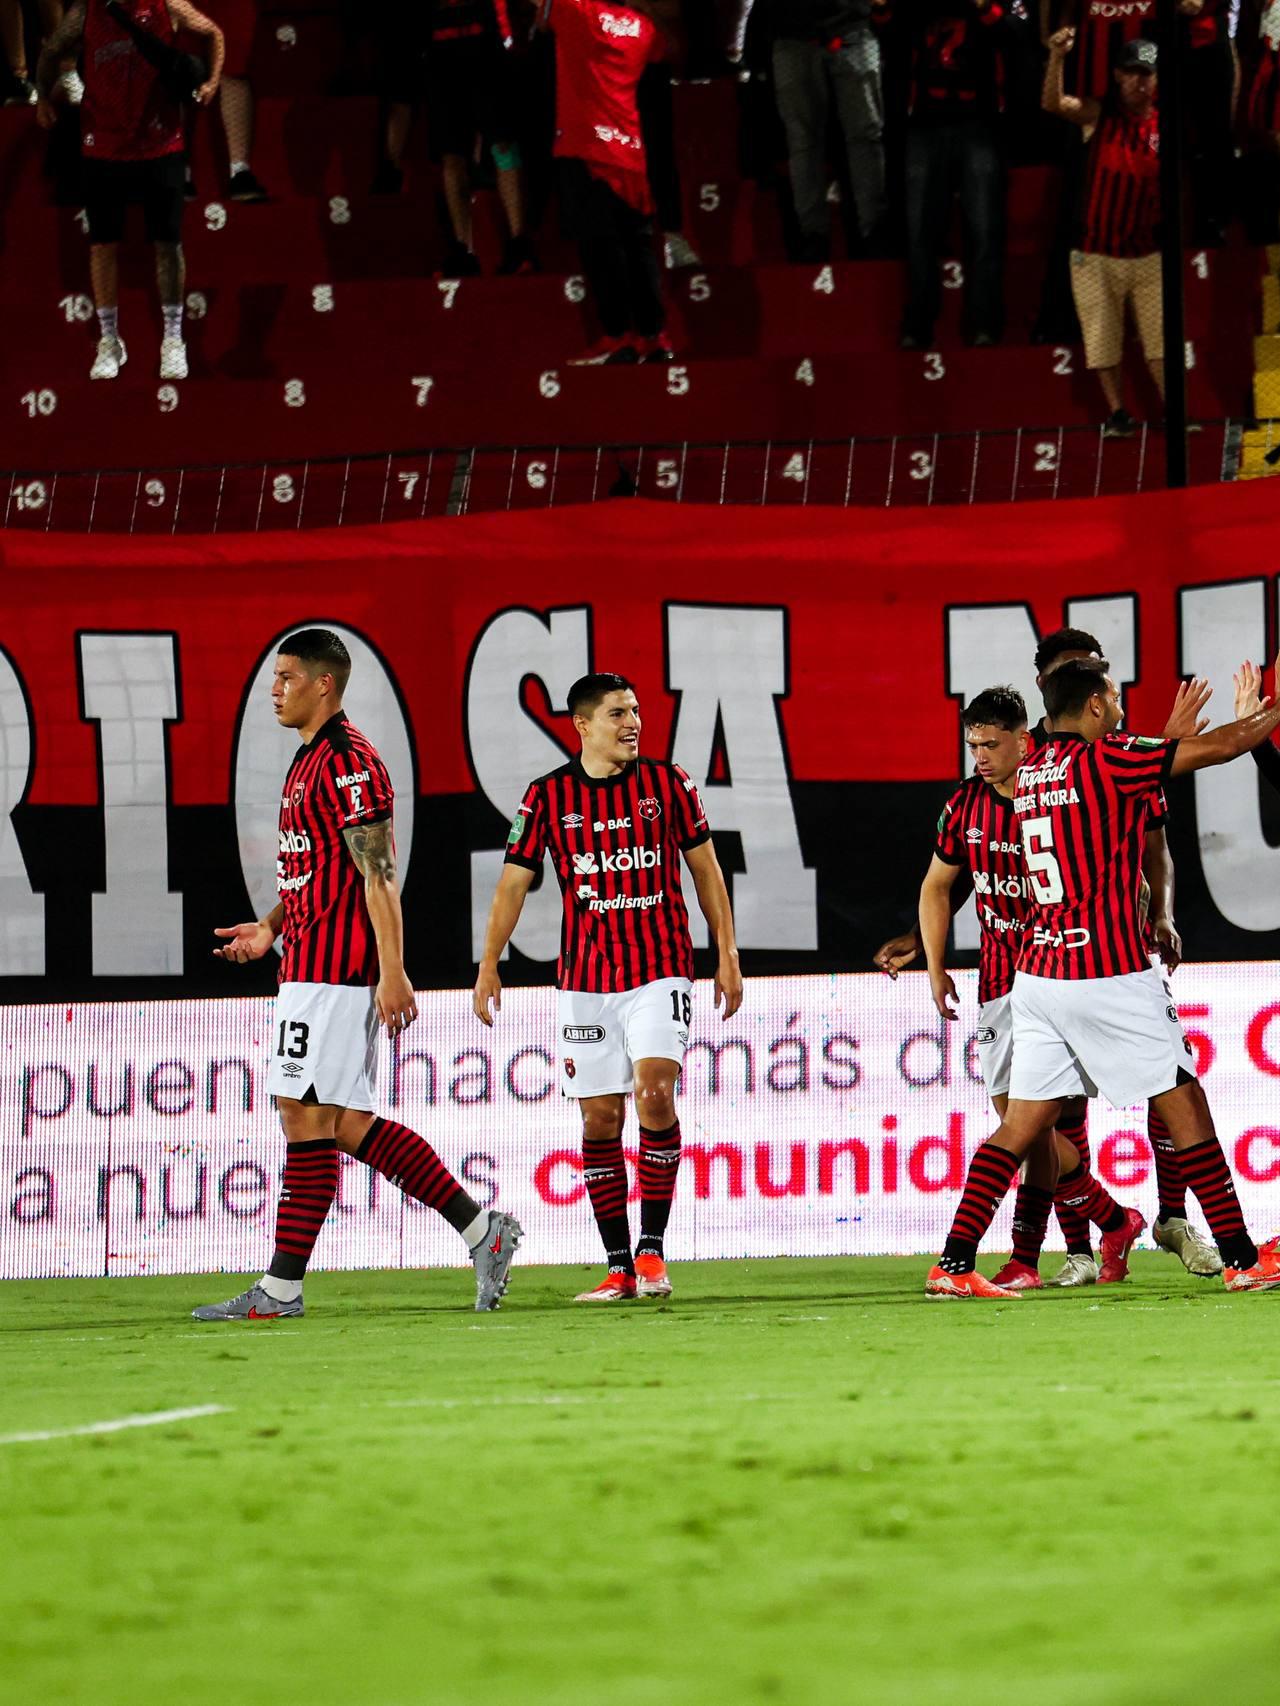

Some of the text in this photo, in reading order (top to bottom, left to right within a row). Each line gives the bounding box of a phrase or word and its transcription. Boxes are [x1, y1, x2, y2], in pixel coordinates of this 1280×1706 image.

[329, 196, 350, 224] 8
[700, 184, 720, 211] 5
[204, 203, 227, 231] 9
[565, 276, 585, 303] 6
[690, 275, 710, 301] 5
[813, 266, 835, 294] 4
[944, 262, 964, 289] 3
[59, 294, 94, 323] 10
[187, 292, 207, 320] 9
[312, 285, 333, 312] 8
[438, 280, 460, 309] 7
[796, 358, 815, 387] 4
[924, 353, 945, 381] 3
[1053, 348, 1073, 375] 2
[284, 379, 305, 407] 8
[411, 377, 433, 406] 7
[539, 370, 560, 398] 6
[667, 366, 689, 395] 5
[21, 389, 56, 418] 10
[157, 385, 179, 412] 9
[783, 453, 805, 482] 4
[910, 451, 931, 479] 3
[1034, 443, 1057, 471] 2
[399, 472, 419, 500] 7
[527, 461, 546, 488] 6
[656, 460, 678, 488] 5
[13, 480, 46, 511] 10
[145, 480, 165, 507] 9
[272, 474, 294, 503] 8
[335, 770, 371, 789] Mobil
[1017, 755, 1072, 790] Tropical
[1040, 787, 1080, 807] MORA
[607, 816, 632, 831] BAC
[600, 844, 662, 873] kölbi
[1000, 841, 1021, 856] BAC
[1021, 816, 1065, 906] 5
[588, 889, 664, 913] medismart
[670, 989, 692, 1027] 18
[276, 1019, 310, 1059] 13
[564, 1028, 599, 1040] ABUS
[676, 1011, 865, 1097] más
[282, 1071, 302, 1079] umbro
[10, 1164, 55, 1223] a
